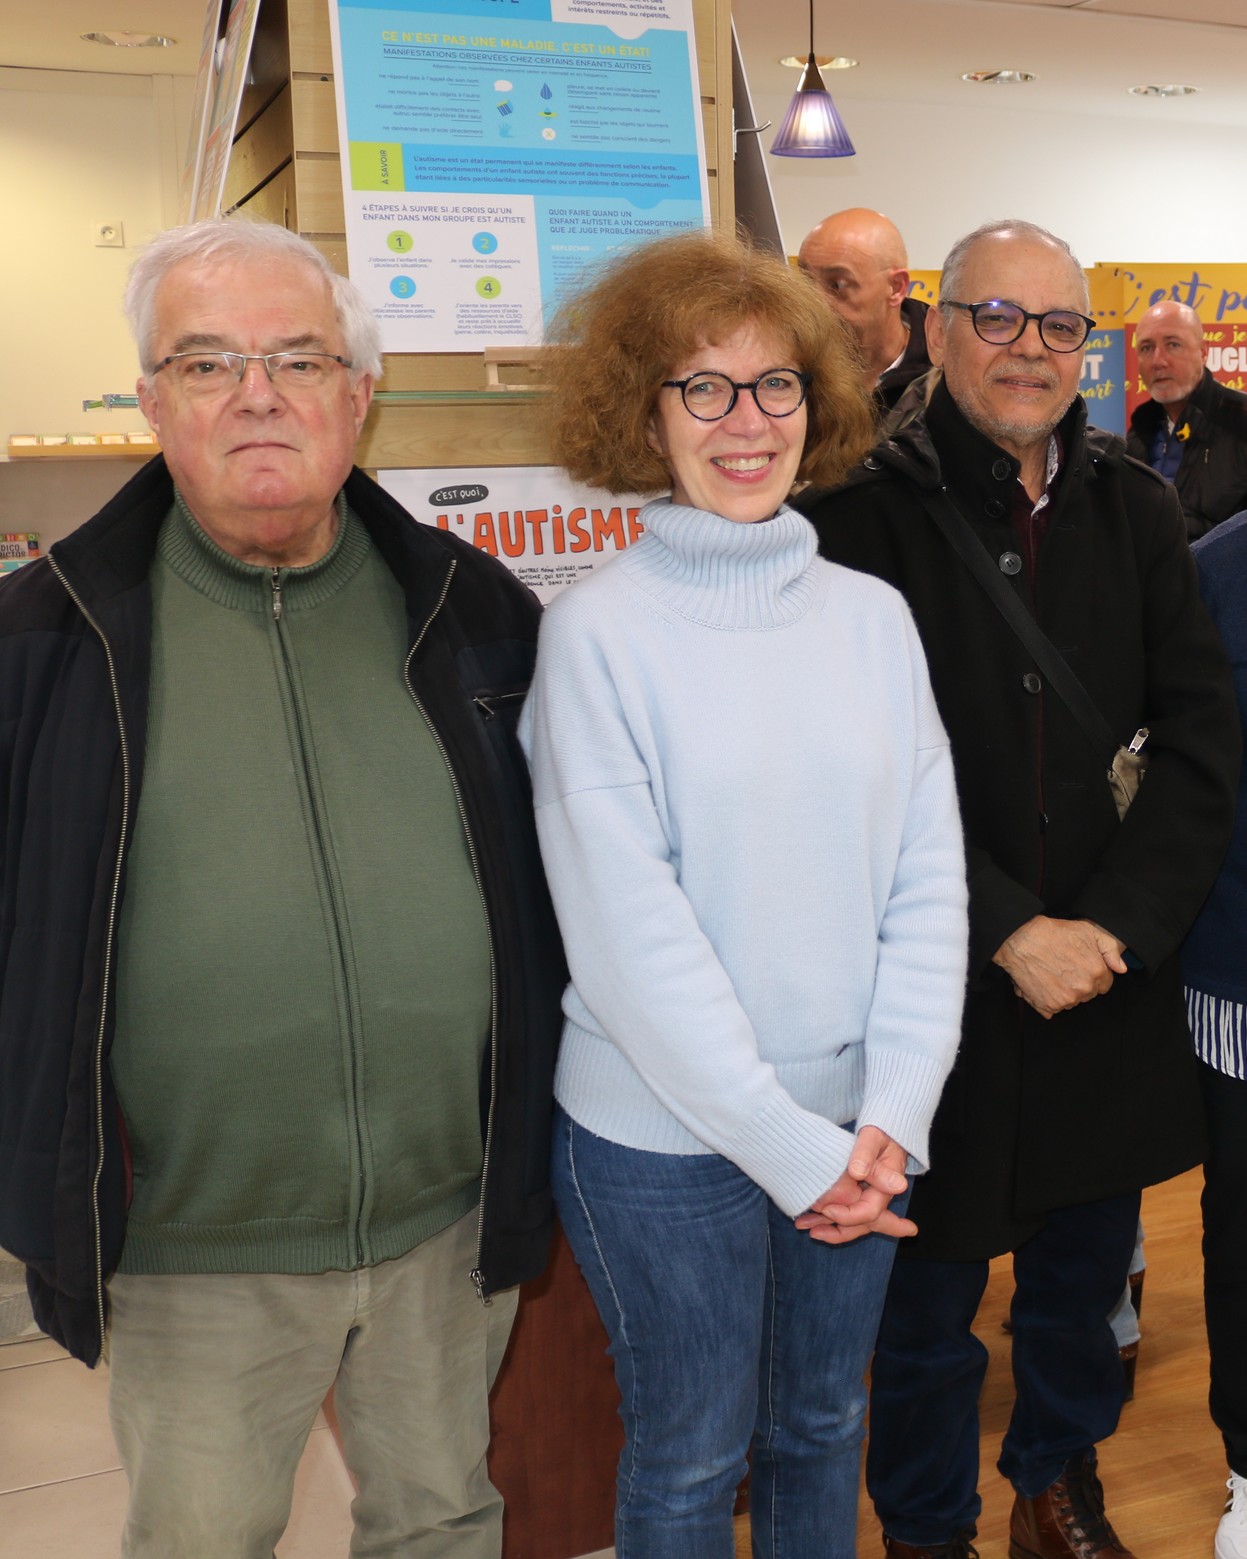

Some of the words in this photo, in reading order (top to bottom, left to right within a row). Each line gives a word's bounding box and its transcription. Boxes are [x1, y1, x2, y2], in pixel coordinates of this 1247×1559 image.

[572, 0, 627, 10] comportements,
[640, 12, 670, 20] répétitifs.
[382, 31, 399, 42] CE
[402, 33, 440, 44] N'EST
[443, 35, 468, 46] PAS
[471, 37, 496, 48] UNE
[562, 42, 594, 53] C'EST
[597, 44, 616, 55] UN
[619, 44, 650, 57] ÉTAT!
[384, 49, 456, 59] MANIFESTATIONS
[459, 52, 507, 62] OBSERVÉES
[534, 57, 573, 65] CERTAINS
[575, 59, 611, 68] ENFANTS
[613, 61, 652, 70] AUTISTES
[380, 150, 388, 178] SAVOIR
[428, 166, 481, 175] comportements
[600, 228, 662, 236] PROBLÉMATIQUE
[480, 238, 490, 250] 2
[398, 282, 408, 292] 3
[484, 282, 492, 292] 4
[1202, 331, 1223, 342] ue
[1231, 325, 1247, 345] je
[436, 490, 457, 502] C'EST
